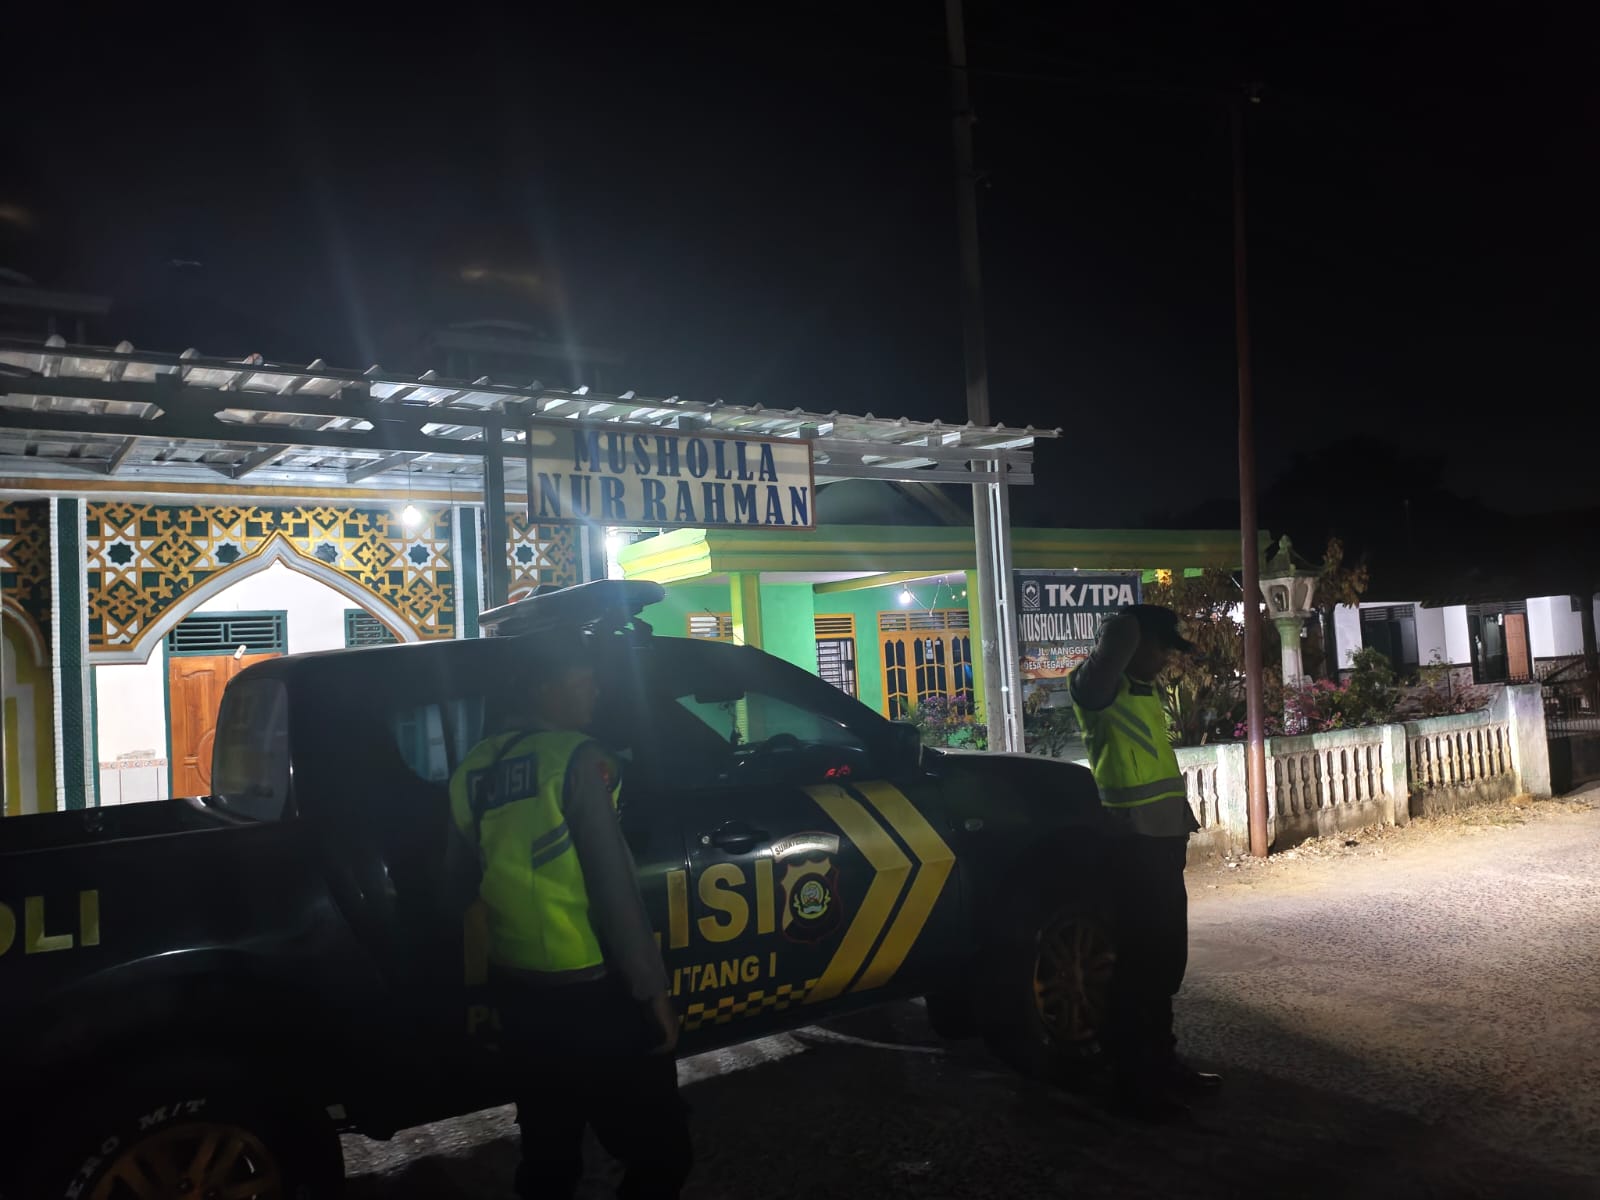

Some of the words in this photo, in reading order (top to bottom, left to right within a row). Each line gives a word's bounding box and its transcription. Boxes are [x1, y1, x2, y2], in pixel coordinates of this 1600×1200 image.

[574, 430, 778, 482] MUSHOLLA
[538, 473, 627, 519] NUR
[641, 478, 808, 526] RAHMAN
[1044, 583, 1135, 607] TK/TPA
[1018, 612, 1072, 641] MUSHOLLA
[1073, 612, 1094, 640] NUR
[1050, 646, 1088, 656] MANGGIS
[668, 953, 760, 997] ITANG
